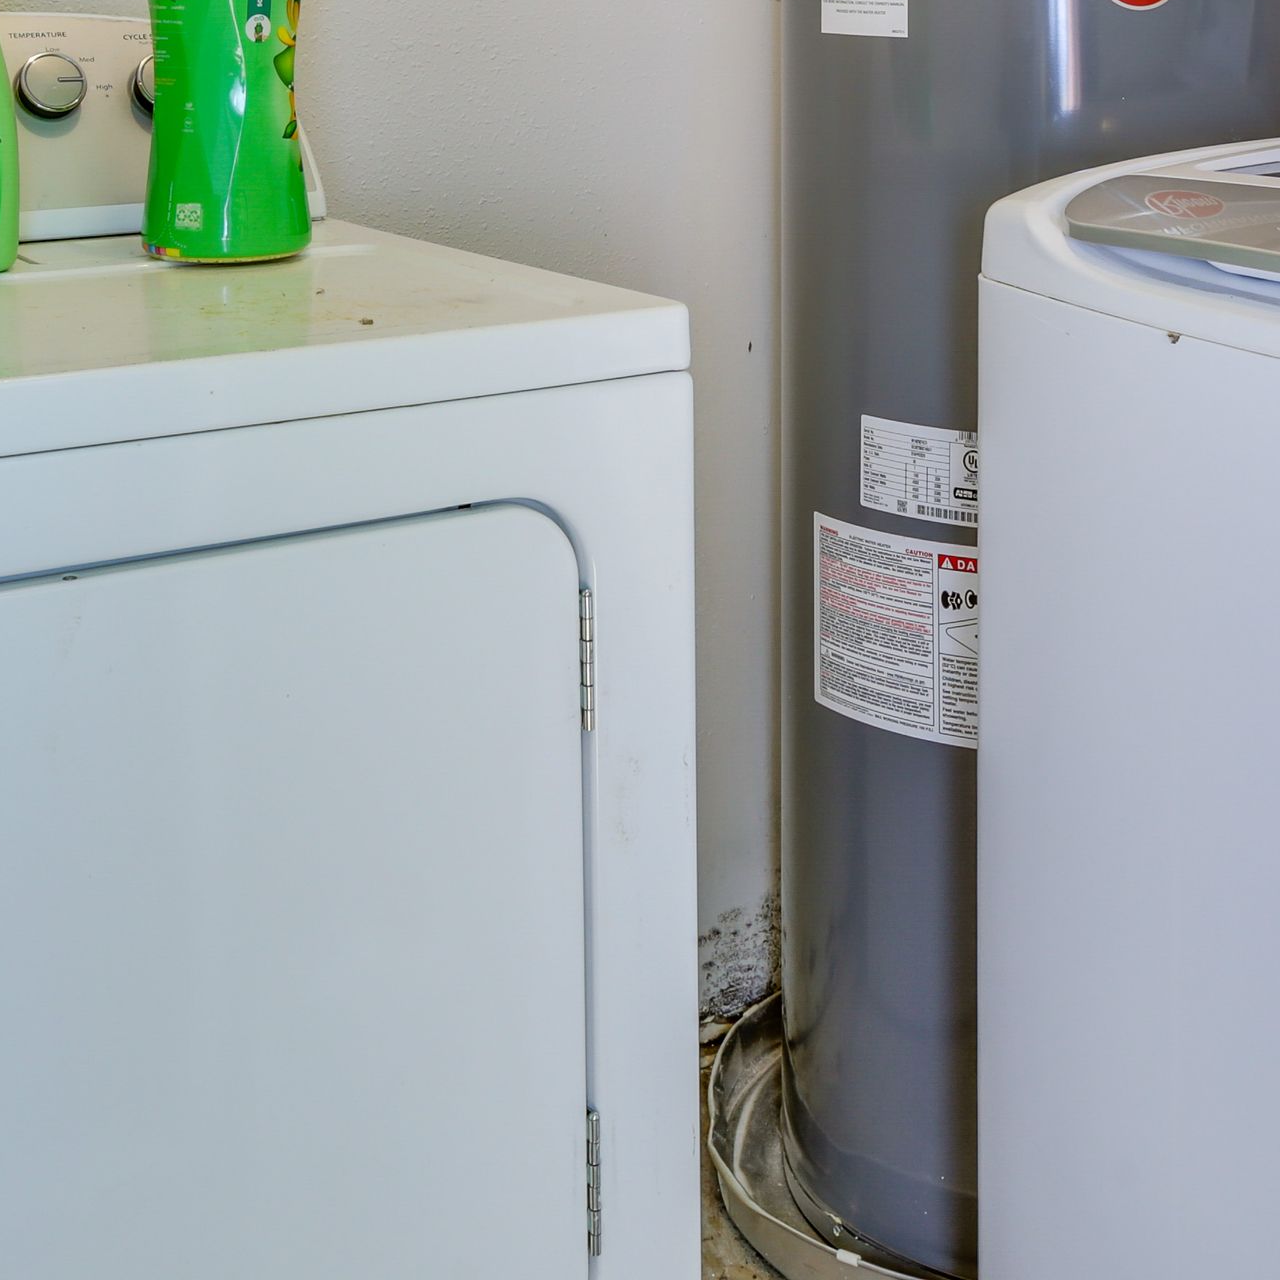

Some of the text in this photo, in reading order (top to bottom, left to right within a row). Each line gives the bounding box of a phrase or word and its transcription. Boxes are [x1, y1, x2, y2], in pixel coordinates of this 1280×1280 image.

[9, 31, 67, 39] TEMPERATURE
[123, 33, 148, 41] CYCLE
[96, 83, 113, 91] High
[905, 548, 933, 558] CAUTION
